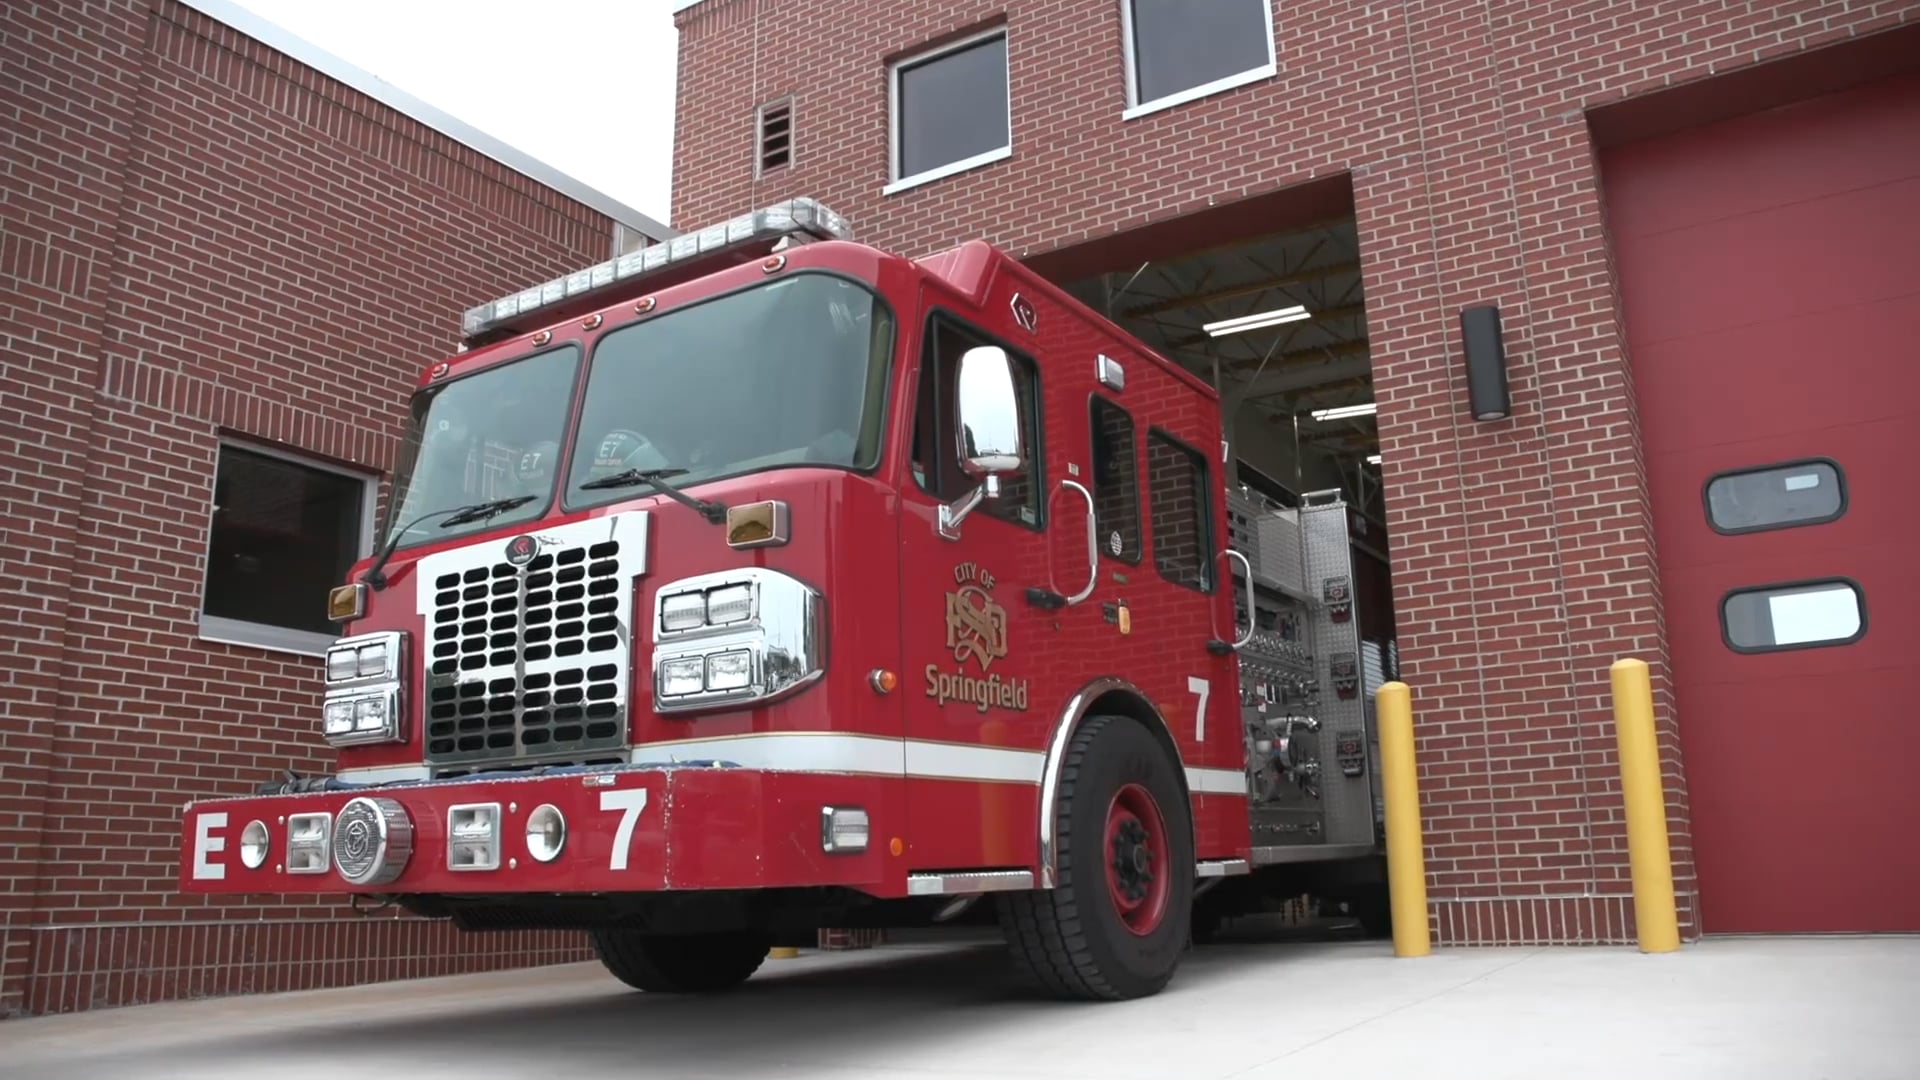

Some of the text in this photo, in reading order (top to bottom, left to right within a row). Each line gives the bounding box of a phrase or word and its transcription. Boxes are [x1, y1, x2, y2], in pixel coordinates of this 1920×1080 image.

[520, 453, 542, 470] E7
[599, 441, 618, 458] E7
[954, 562, 996, 588] CITY OF
[926, 664, 1028, 712] Springfield
[1188, 677, 1210, 742] 7
[193, 788, 647, 880] E 7
